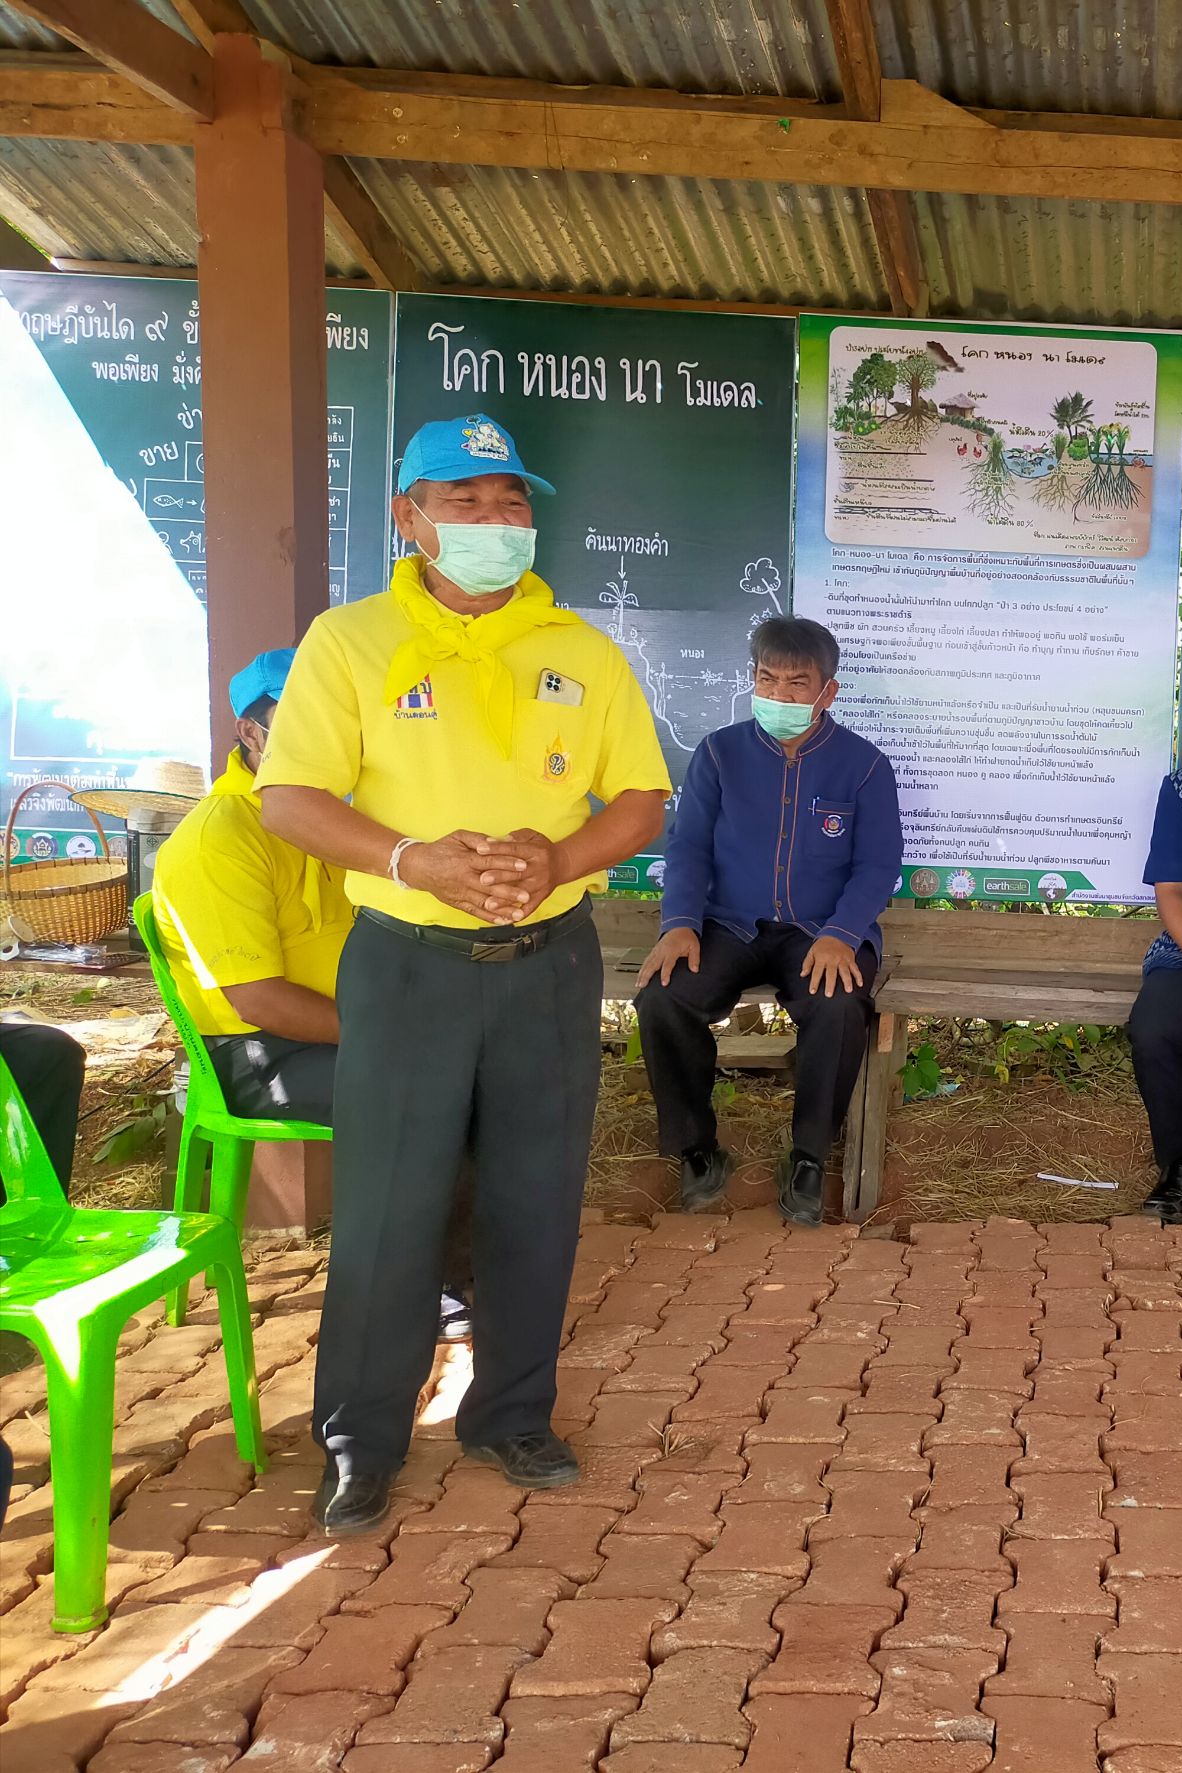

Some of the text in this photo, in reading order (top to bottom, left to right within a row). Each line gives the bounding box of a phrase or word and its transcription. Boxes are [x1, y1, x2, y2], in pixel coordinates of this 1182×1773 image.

[183, 300, 200, 344] ขั้
[961, 346, 989, 359] โคก
[994, 351, 1032, 361] หนอง
[1042, 353, 1060, 363] นา
[92, 354, 159, 383] พอเพียง
[427, 322, 757, 409] โคก หนอง นา โมเดล
[139, 441, 180, 466] ขาย
[887, 551, 908, 561] โมเดล
[914, 552, 925, 561] คือ
[1012, 602, 1018, 610] 3
[1020, 601, 1041, 611] อย่าง
[680, 648, 705, 659] หนอง
[986, 883, 1028, 892] earthsafe
